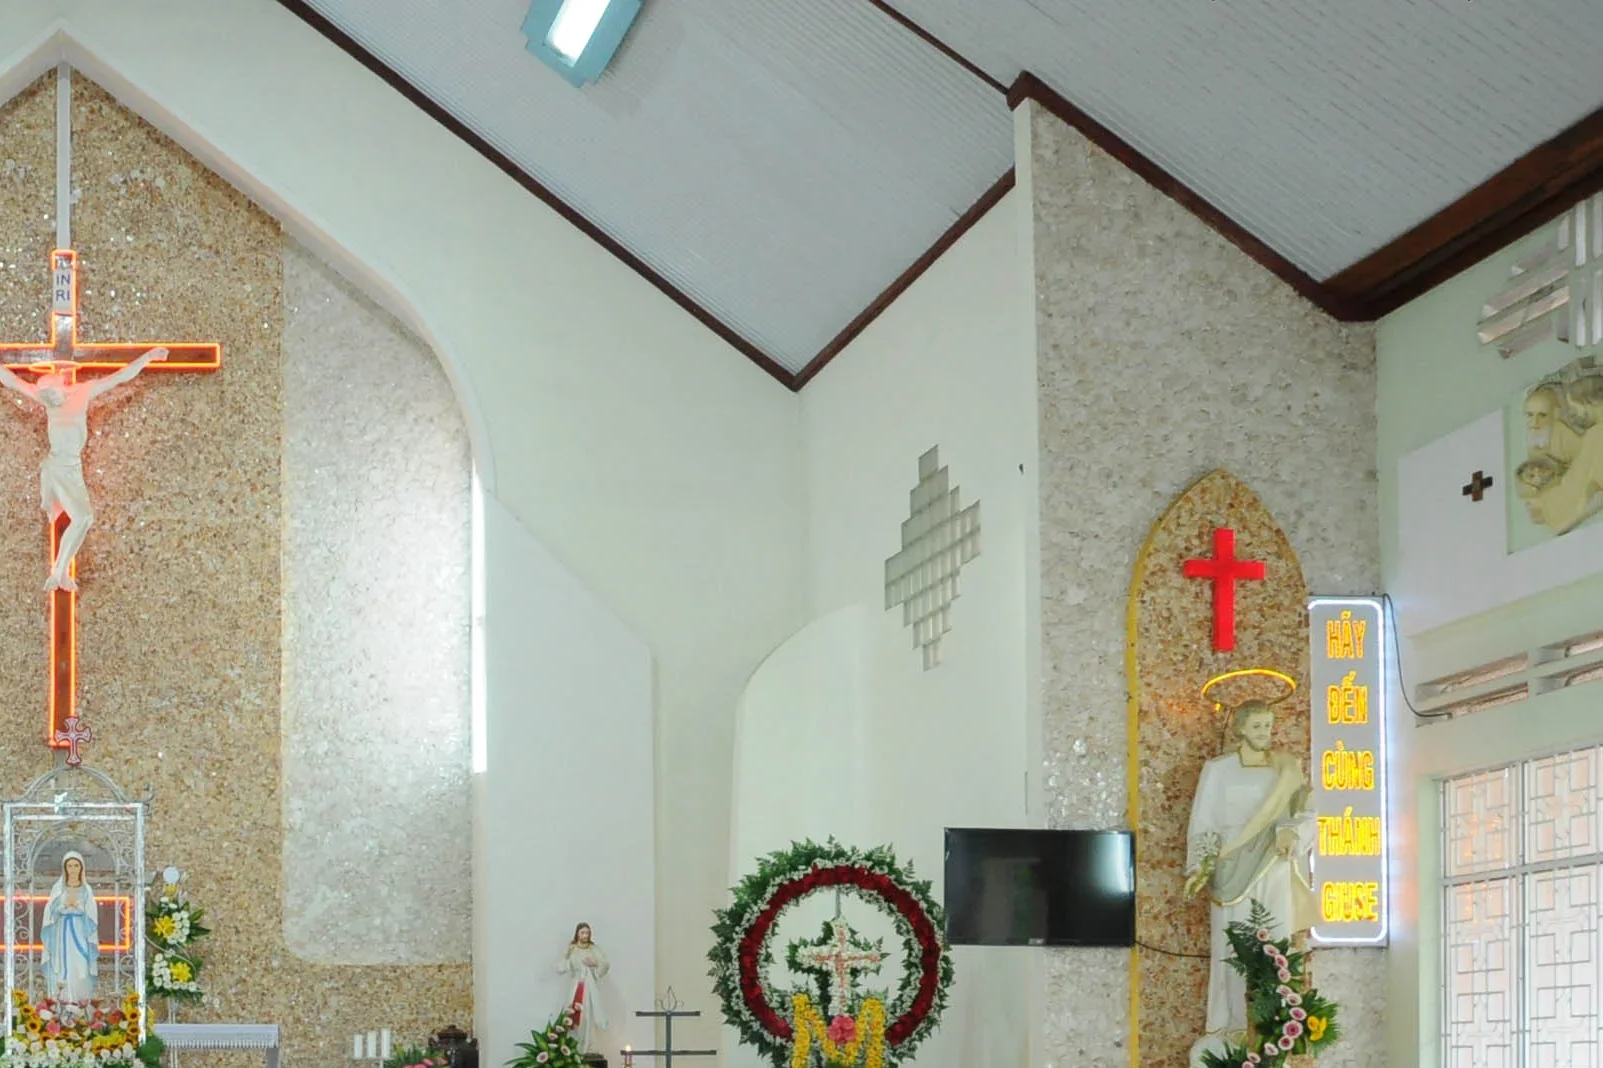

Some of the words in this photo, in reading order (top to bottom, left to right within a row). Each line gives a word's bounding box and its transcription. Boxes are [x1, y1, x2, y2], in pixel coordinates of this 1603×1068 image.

[56, 274, 71, 286] IN
[56, 289, 71, 302] RI
[1326, 611, 1365, 659] HÃY
[1327, 671, 1368, 724] ĐẾN
[1322, 741, 1374, 790] CÙNG
[1317, 806, 1381, 857] THÁNH
[1321, 880, 1379, 922] GIUSE
